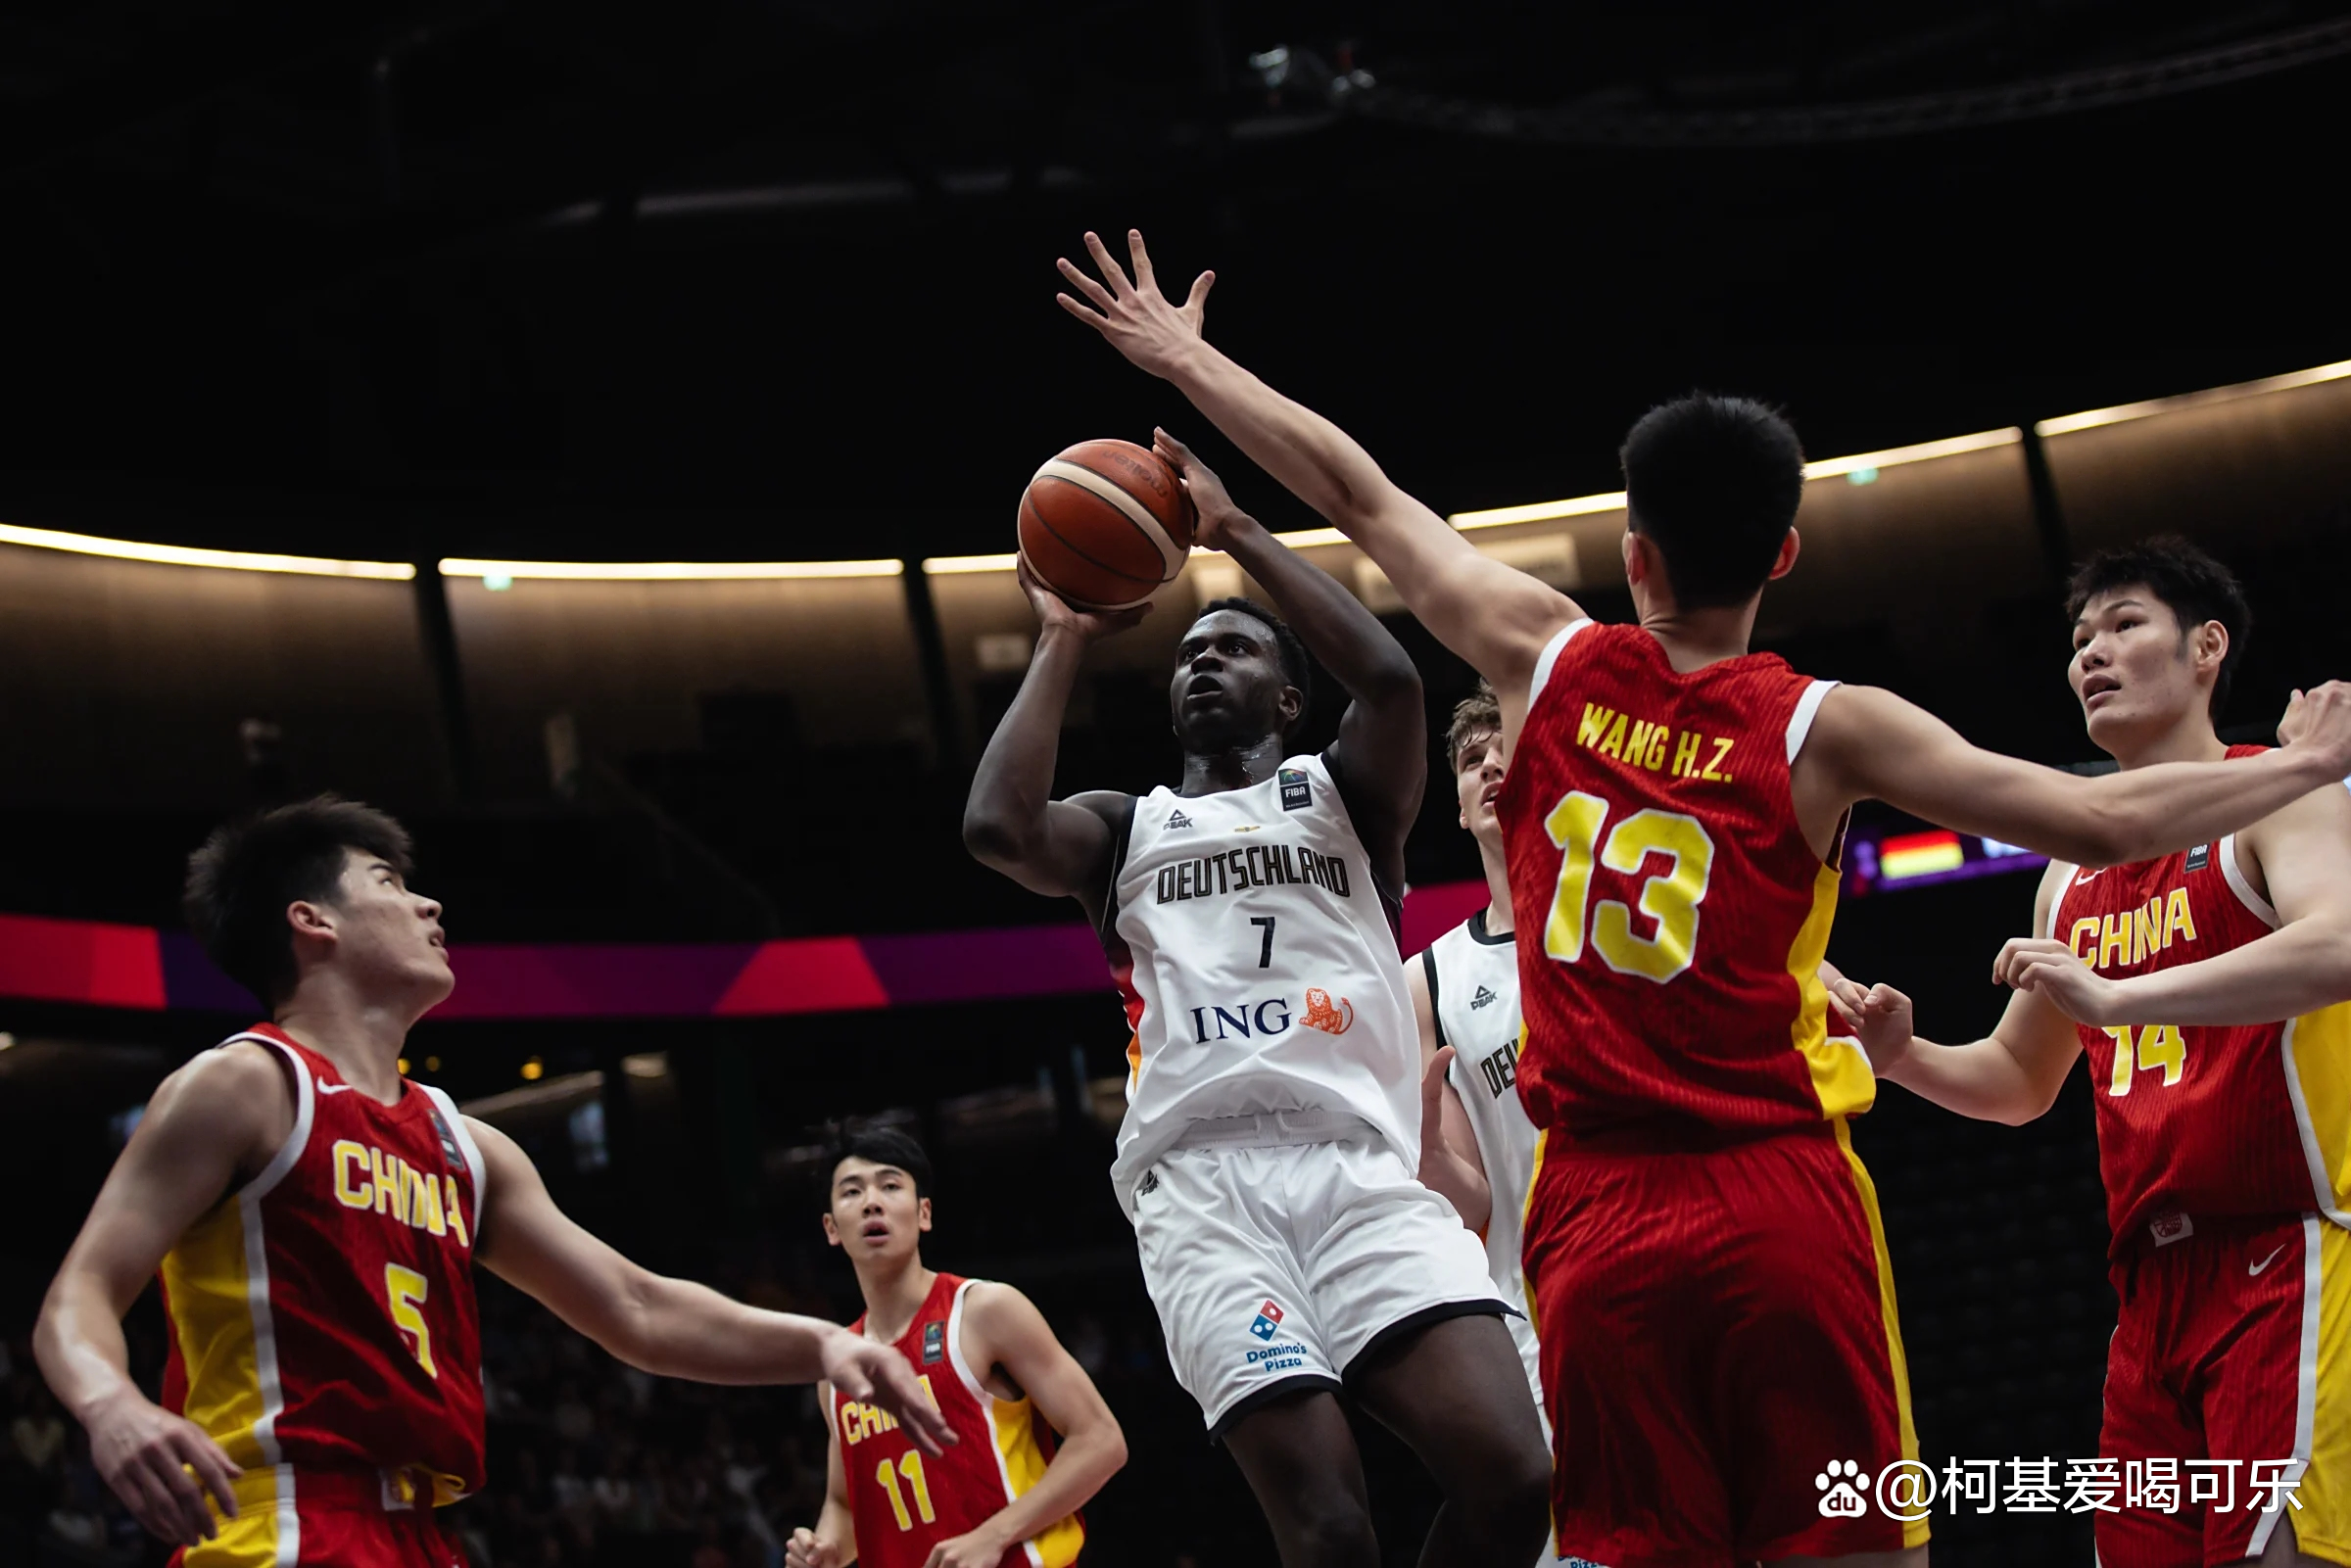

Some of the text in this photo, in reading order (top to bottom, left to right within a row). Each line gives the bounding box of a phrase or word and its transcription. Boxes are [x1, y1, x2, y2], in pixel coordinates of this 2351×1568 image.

[1576, 702, 1735, 783] WANG H.Z.
[1285, 786, 1306, 798] FIBA
[1163, 818, 1193, 831] PEAK
[1157, 844, 1351, 905] DEUTSCHLAND
[1544, 789, 1714, 984] 13
[1250, 917, 1275, 969] 7
[2069, 886, 2197, 970] CHINA
[1190, 998, 1292, 1044] ING
[1470, 991, 1498, 1010] PEAK
[2101, 1024, 2186, 1096] 14
[332, 1139, 469, 1248] CHINA
[385, 1262, 438, 1379] 5
[1246, 1342, 1307, 1363] Domino's
[1265, 1357, 1302, 1372] Pizza
[876, 1449, 936, 1532] 11
